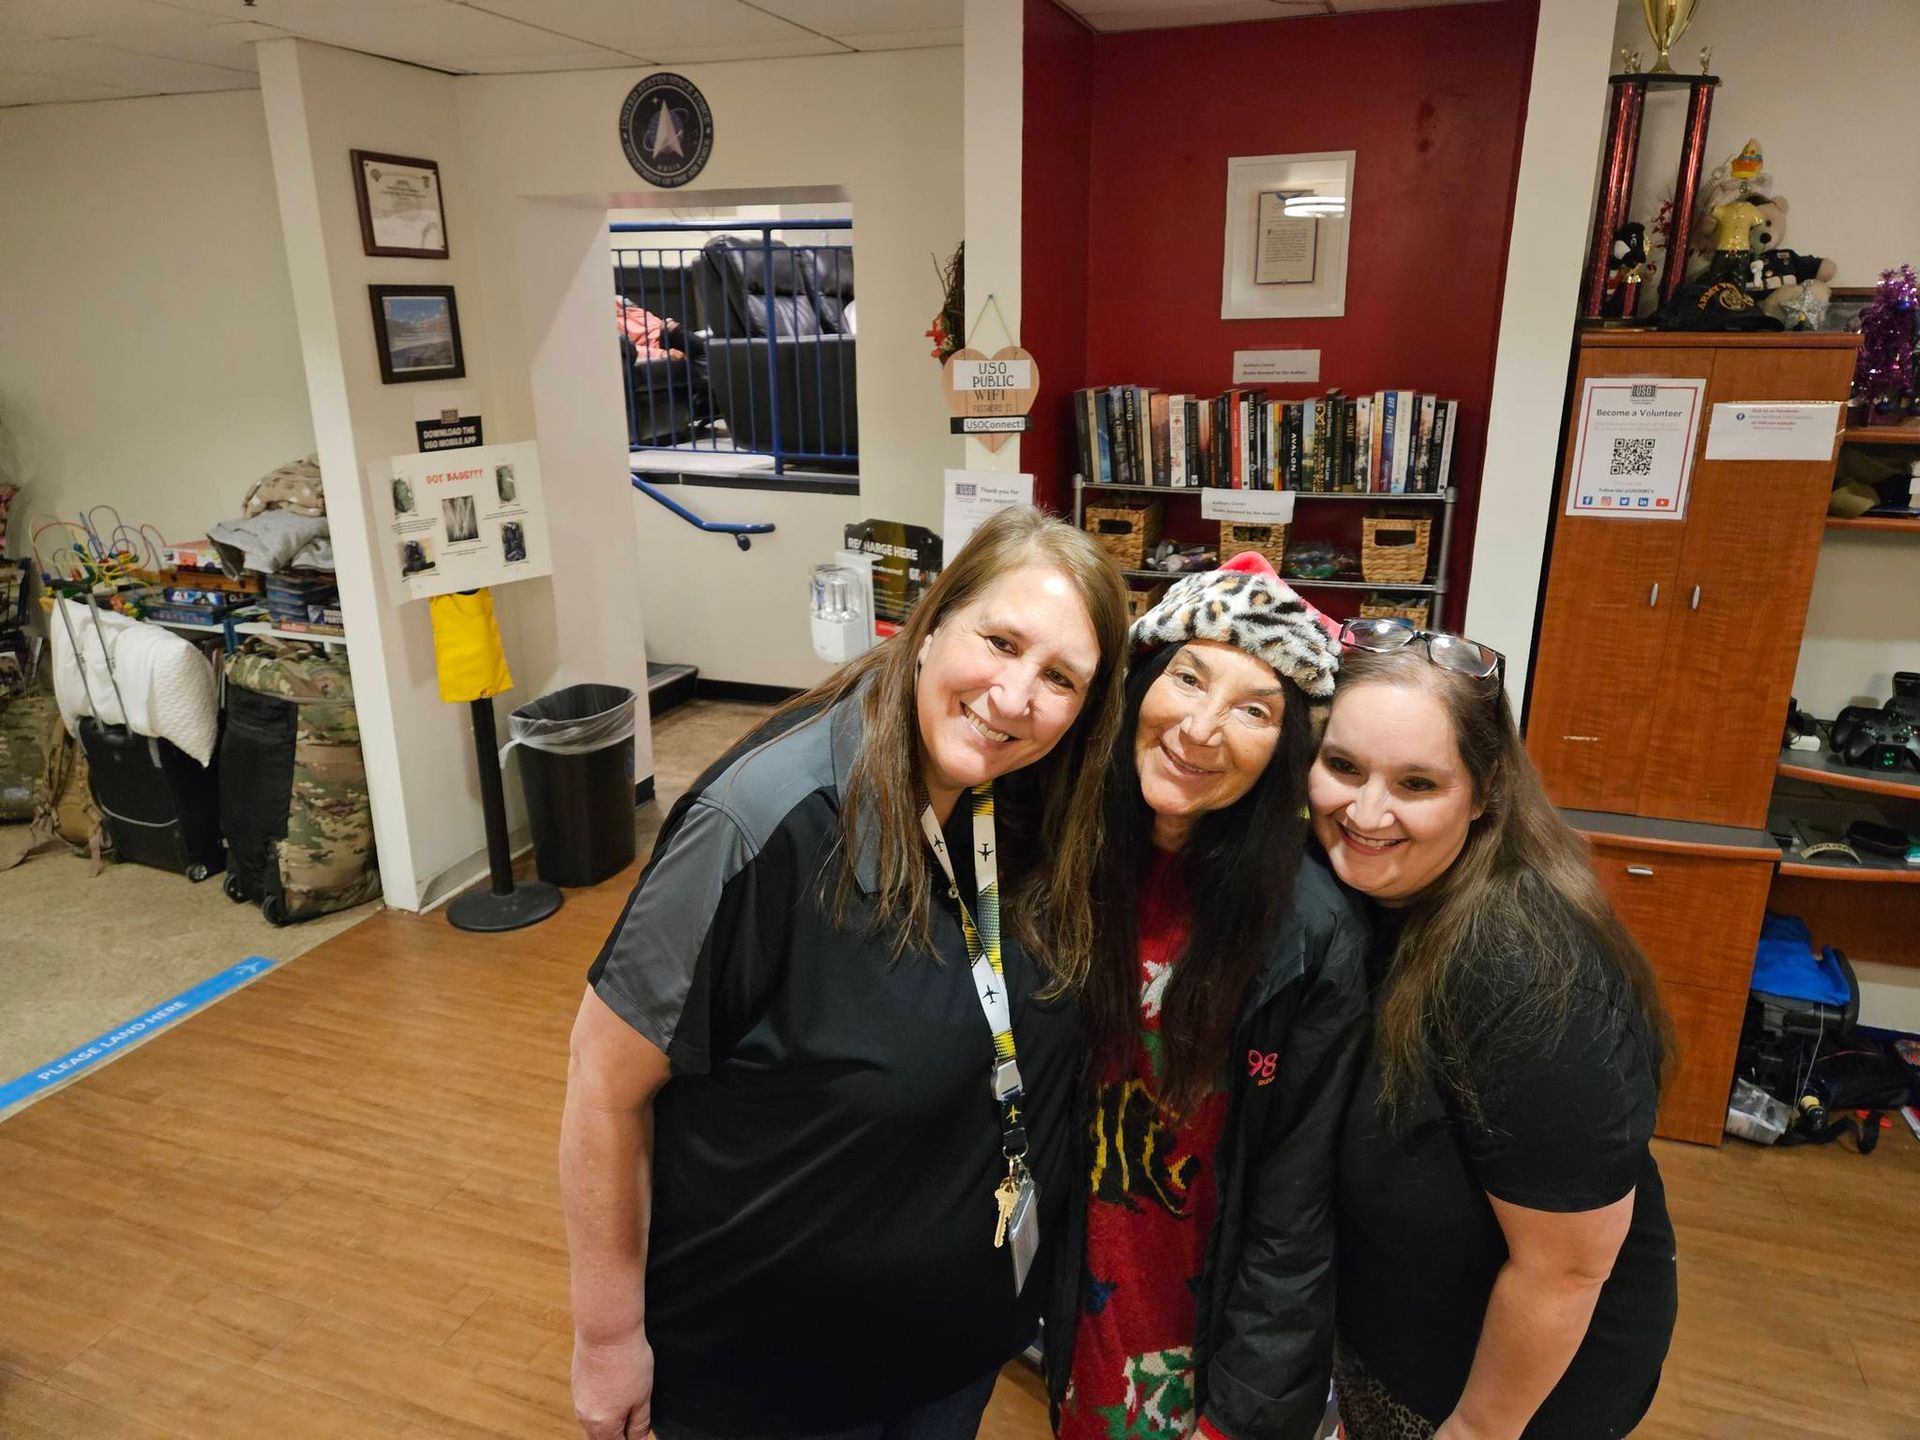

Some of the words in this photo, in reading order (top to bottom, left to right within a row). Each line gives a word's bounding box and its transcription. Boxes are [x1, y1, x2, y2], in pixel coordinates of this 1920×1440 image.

[978, 362, 1007, 375] USO
[972, 375, 1014, 388] PUBLIC
[974, 389, 1005, 401] WIFI
[1596, 408, 1630, 417] Become
[1639, 409, 1682, 418] Volunteer
[966, 420, 1024, 429] USOConnect!
[423, 427, 462, 439] DOWNLOAD
[462, 425, 476, 434] THE
[423, 440, 438, 449] USO
[463, 435, 477, 444] APP
[425, 474, 443, 485] GOT
[893, 545, 919, 560] HERE
[37, 1046, 102, 1081] PLEASE
[100, 1021, 146, 1049] LAND
[145, 1000, 188, 1024] HERE
[1248, 1049, 1278, 1077] 98
